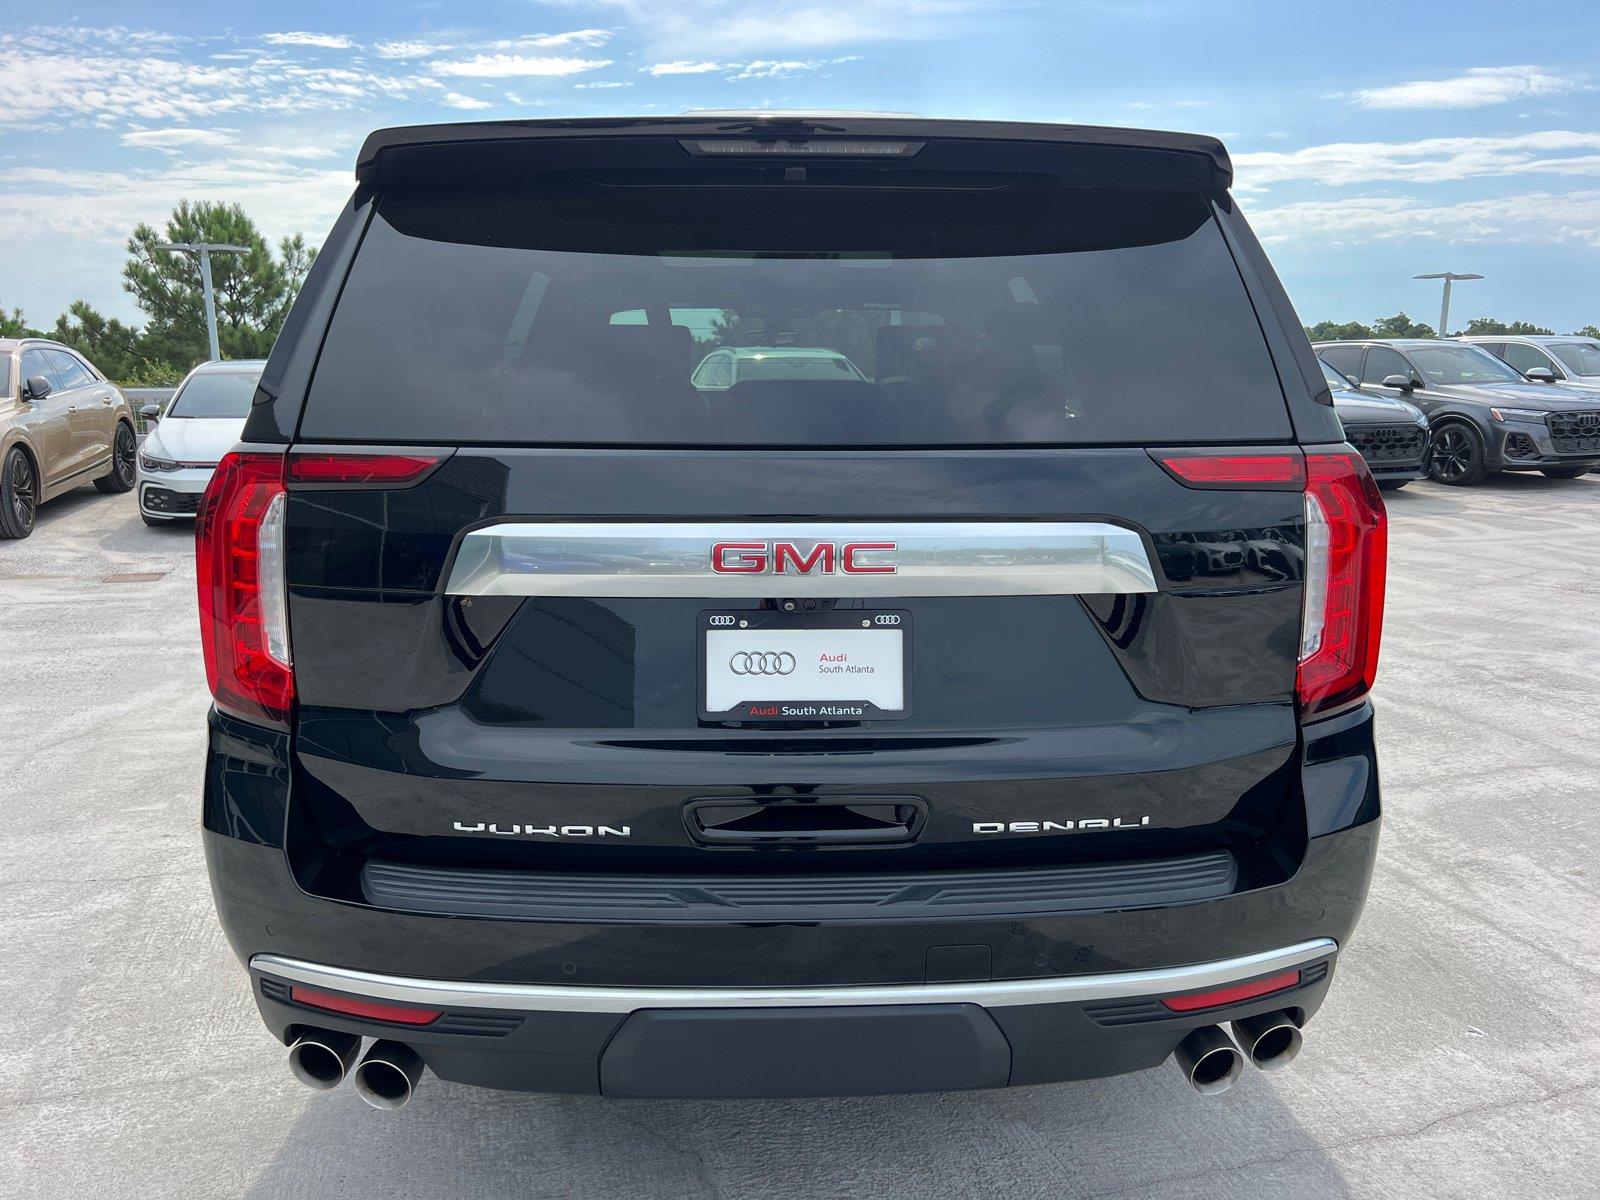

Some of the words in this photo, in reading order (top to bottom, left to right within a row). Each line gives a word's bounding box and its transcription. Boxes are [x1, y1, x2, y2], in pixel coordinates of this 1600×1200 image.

[711, 541, 898, 575] GMC
[819, 653, 848, 662] Audi
[818, 665, 844, 674] South
[845, 665, 875, 674] Atlanta
[749, 706, 779, 716] Audi
[781, 706, 816, 716] South
[818, 706, 863, 716] Atlanta
[453, 821, 631, 837] YUKON
[972, 815, 1150, 834] DENALI
